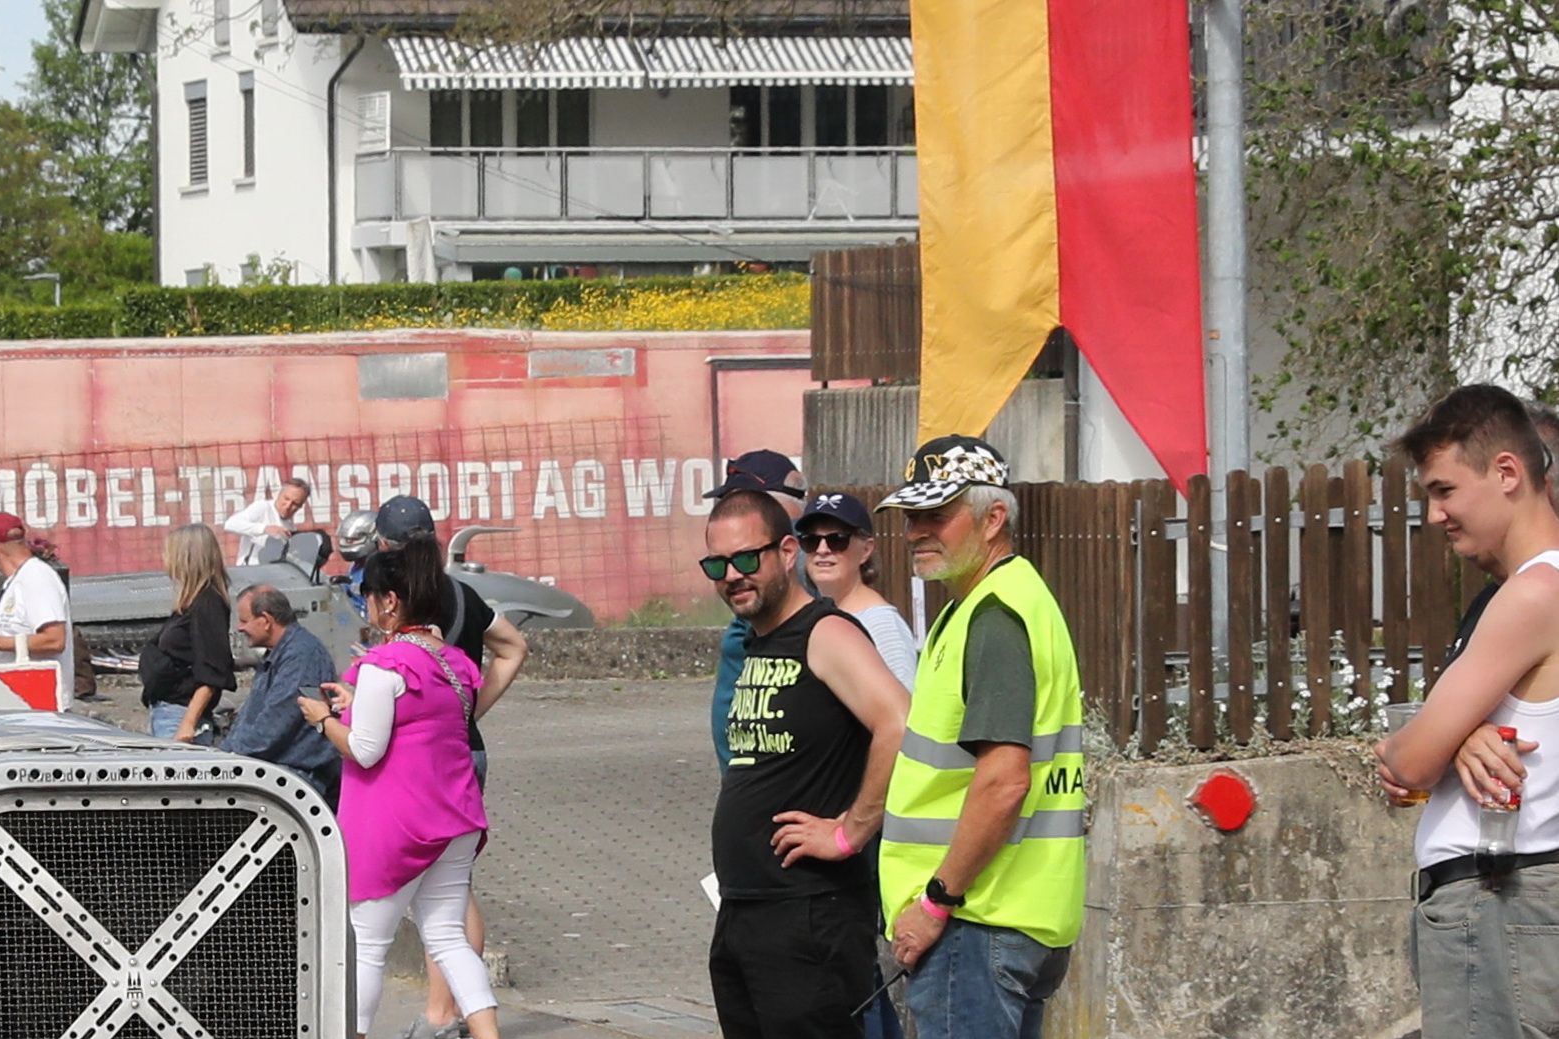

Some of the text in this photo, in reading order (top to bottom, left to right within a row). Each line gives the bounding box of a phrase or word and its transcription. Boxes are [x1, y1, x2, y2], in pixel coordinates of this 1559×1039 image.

[532, 459, 607, 519] AG
[621, 457, 731, 518] WO
[164, 765, 239, 781] wiernd
